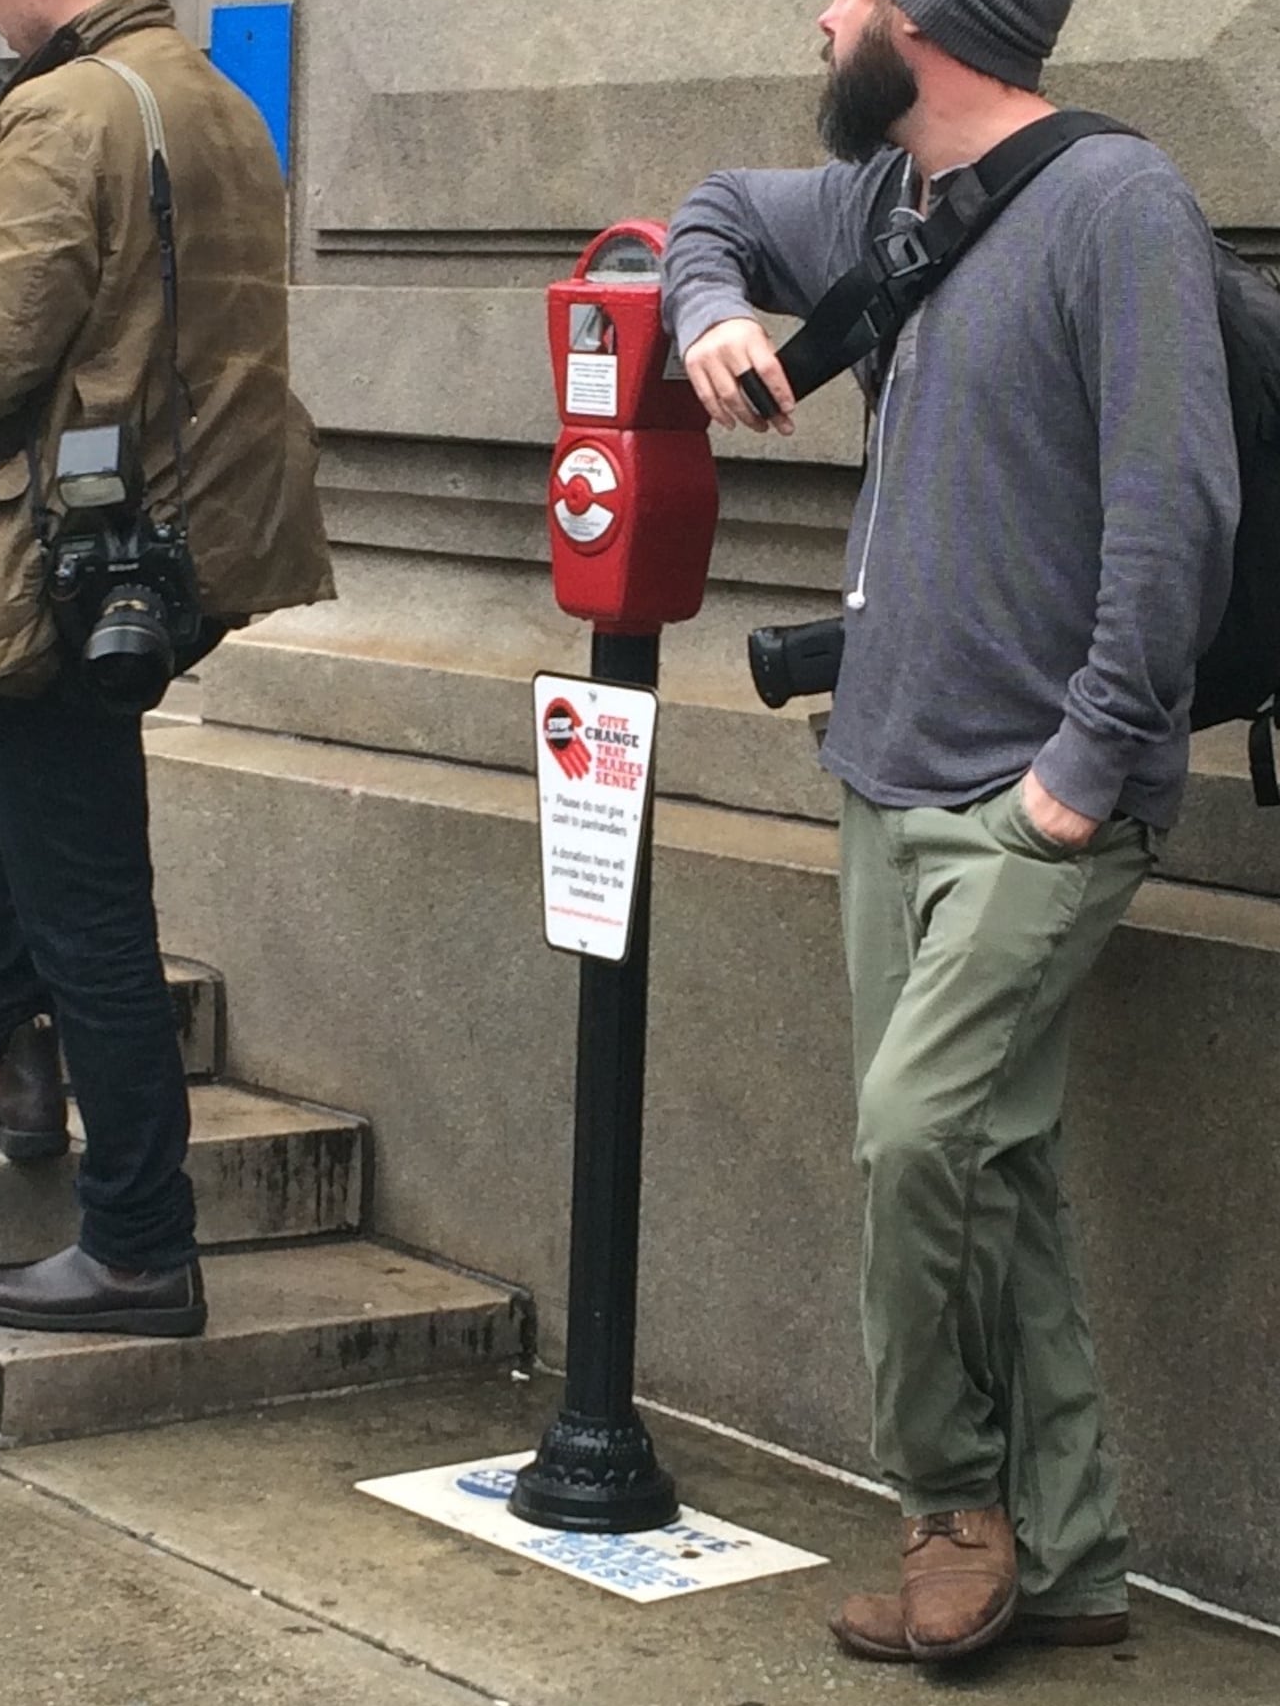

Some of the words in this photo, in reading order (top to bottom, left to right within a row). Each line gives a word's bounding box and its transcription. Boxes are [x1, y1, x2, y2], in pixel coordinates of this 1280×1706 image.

[598, 714, 629, 731] GIVE
[585, 726, 639, 748] CHANGE
[597, 743, 626, 759] THAT
[596, 756, 643, 777] MAKES
[595, 771, 637, 791] SENSE
[556, 793, 580, 810] Please
